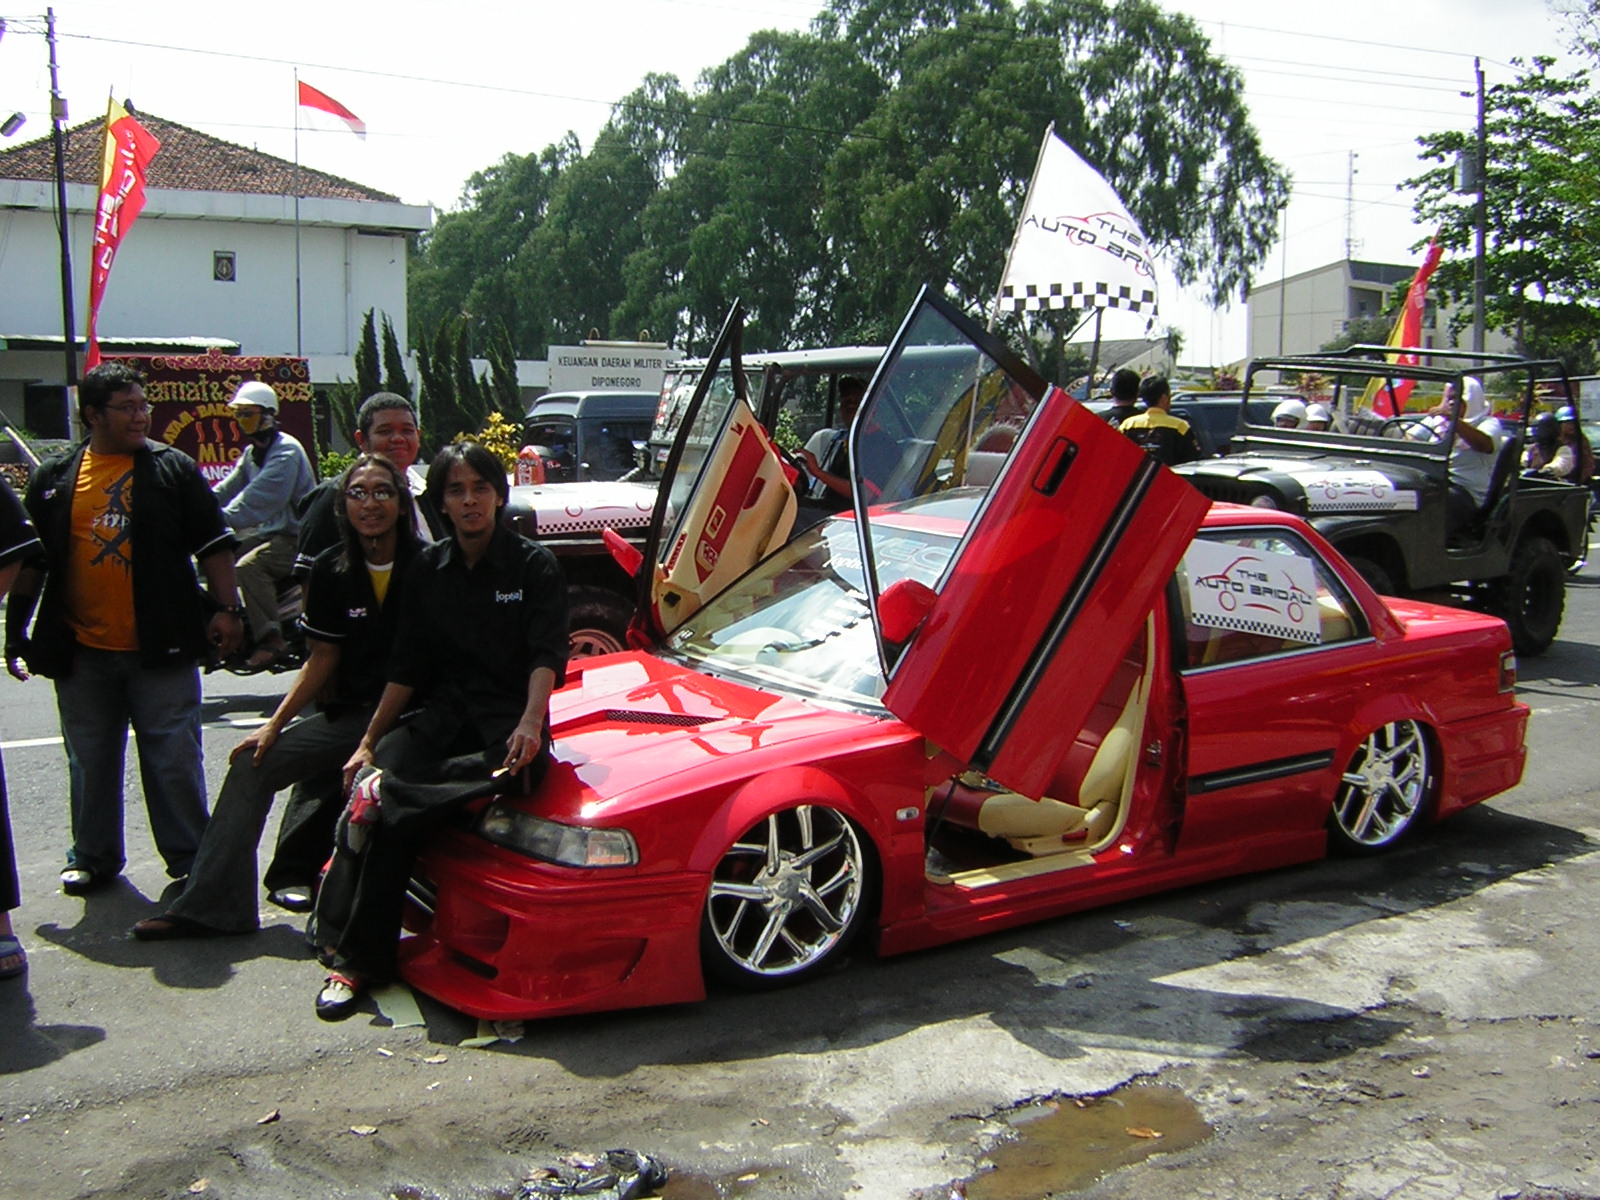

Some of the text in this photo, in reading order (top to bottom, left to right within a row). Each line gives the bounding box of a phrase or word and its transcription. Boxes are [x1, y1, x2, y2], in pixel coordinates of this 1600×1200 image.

[1024, 214, 1097, 245] AUTO
[1096, 217, 1143, 247] THE
[558, 357, 598, 368] KEUANGAN
[601, 357, 631, 368] DAERAH
[634, 358, 662, 369] MILITER
[591, 377, 642, 388] DIPONEGORO
[198, 443, 242, 463] Mie
[1236, 569, 1268, 582] THE
[1195, 576, 1313, 605] AUTO BRIDAL
